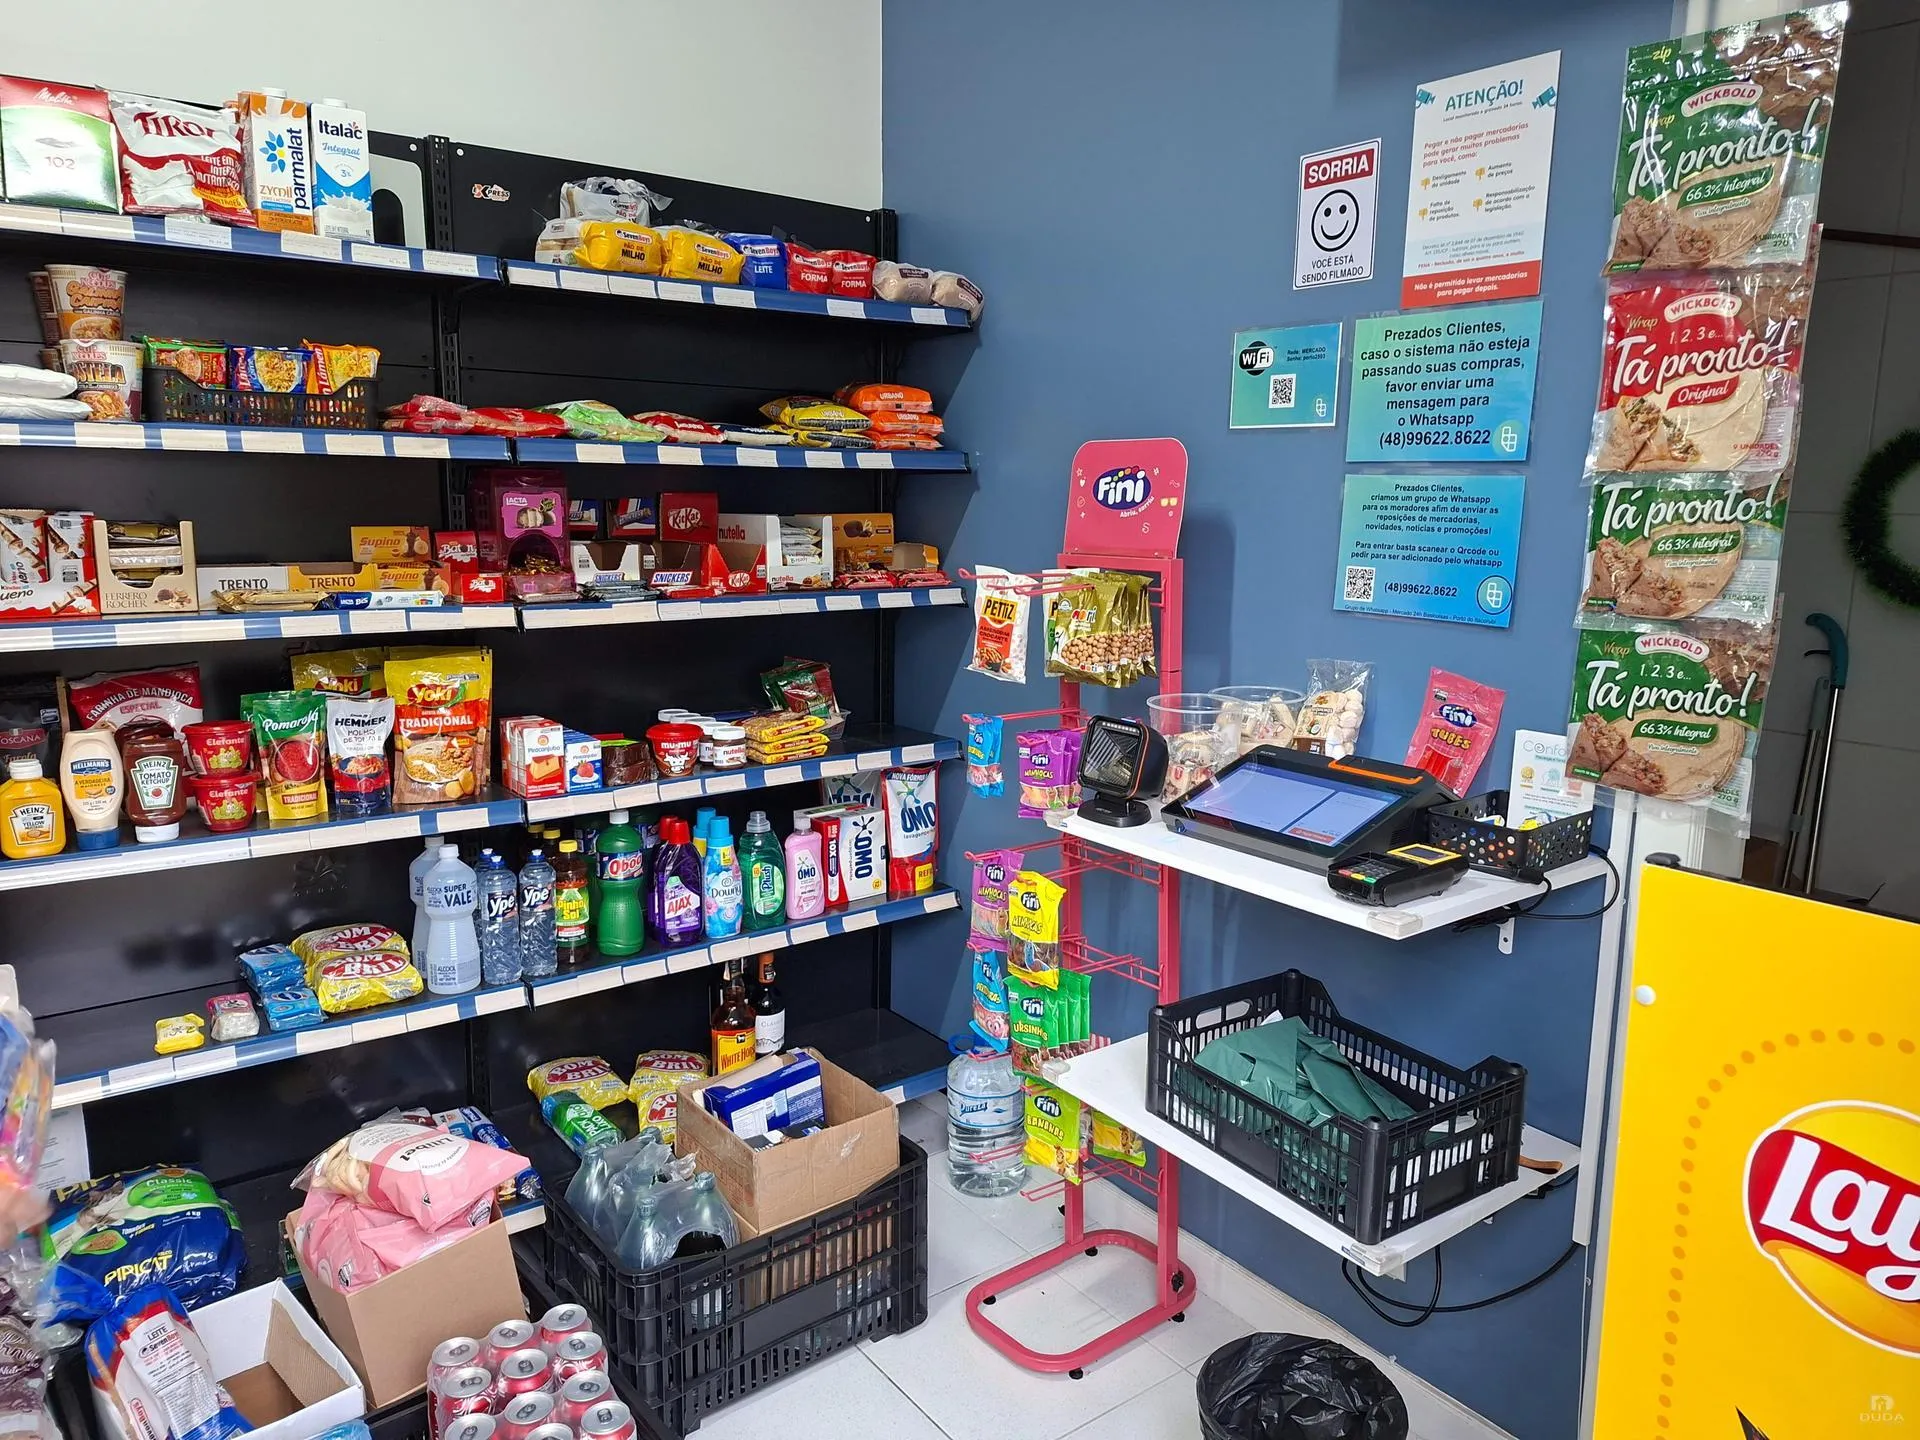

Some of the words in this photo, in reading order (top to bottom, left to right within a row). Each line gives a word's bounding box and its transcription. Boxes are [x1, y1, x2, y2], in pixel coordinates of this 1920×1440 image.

[1653, 46, 1672, 60] zip
[1446, 79, 1524, 112] ATENÇÃO!
[1687, 87, 1757, 110] WICKBOLD
[318, 119, 363, 140] Italac
[1425, 140, 1444, 150] Pegar
[1450, 136, 1462, 144] não
[1464, 133, 1484, 143] pagar
[1486, 122, 1529, 136] mercadorias
[321, 142, 361, 157] Integral
[1424, 151, 1439, 159] pode
[1441, 146, 1458, 156] gerar
[1460, 142, 1482, 150] muitos
[1484, 134, 1520, 147] problemas
[45, 156, 76, 170] 102
[286, 128, 311, 210] parmalat
[1308, 154, 1370, 183] SORRIA
[1422, 159, 1438, 168] para
[1627, 134, 1674, 196] Tá
[1723, 170, 1767, 194] Integral
[621, 249, 645, 261] MILHO
[1312, 255, 1333, 269] VOCÊ
[697, 262, 723, 275] MILHO
[754, 265, 773, 274] LEITE
[1302, 269, 1326, 284] SENDO
[1328, 265, 1363, 281] FILMADO
[801, 273, 828, 282] FORMA
[841, 280, 867, 288] FORMA
[1414, 282, 1427, 290] Não
[1434, 278, 1466, 288] permitido
[1485, 271, 1528, 282] mercadorias
[1437, 288, 1452, 297] para
[1453, 287, 1473, 296] pagar
[1384, 326, 1442, 342] Prezados
[1446, 321, 1506, 337] Clientes,
[1360, 349, 1390, 362] caso
[1393, 349, 1401, 359] o
[1404, 342, 1455, 358] sistema
[1459, 341, 1483, 354] não
[1488, 337, 1530, 353] esteja
[1362, 363, 1422, 380] passando
[1425, 361, 1457, 373] suas
[1461, 356, 1525, 374] compras,
[1612, 335, 1657, 394] Tá
[1385, 379, 1417, 394] favor
[1420, 377, 1462, 391] enviar
[1465, 377, 1494, 388] uma
[1678, 380, 1729, 405] Original
[1386, 396, 1456, 411] mensagem
[1459, 395, 1490, 410] para
[1398, 415, 1405, 427] o
[1409, 413, 1474, 428] Whatsapp
[1379, 428, 1491, 450] (48)99622.8622
[1097, 470, 1145, 505] Fini
[1394, 483, 1429, 492] Prezados
[1430, 484, 1465, 493] Clientes,
[506, 497, 527, 505] LACTA
[1414, 496, 1437, 504] grupo
[1450, 495, 1490, 504] Whatsapp
[1600, 481, 1644, 536] Tá
[1642, 473, 1776, 538] pronto!
[1362, 504, 1378, 513] para
[1390, 504, 1429, 512] moradores
[1431, 504, 1448, 513] afim
[1450, 505, 1460, 513] de
[1462, 506, 1487, 514] enviar
[672, 509, 700, 529] KitKat
[1376, 514, 1416, 524] reposições
[1429, 515, 1480, 525] mercadorias,
[719, 524, 746, 541] nutella
[1365, 523, 1404, 532] novidades,
[1405, 524, 1435, 533] notícias
[1444, 526, 1492, 536] promoções!
[359, 537, 401, 547] Supino
[1355, 541, 1371, 549] Para
[1373, 542, 1394, 550] entrar
[1396, 543, 1416, 551] basta
[1418, 545, 1448, 553] scanear
[1457, 546, 1487, 556] Qrcode
[1692, 535, 1734, 550] Integral
[1351, 551, 1369, 559] pedir
[1371, 553, 1387, 561] para
[1402, 553, 1443, 563] adicionado
[1444, 556, 1462, 564] pelo
[1464, 558, 1503, 568] whatsapp
[309, 576, 356, 588] TRENTO
[380, 570, 419, 581] Supino
[595, 574, 623, 583] SNICKERS
[654, 573, 691, 583] SNICKERS
[729, 572, 749, 586] KitKat
[219, 578, 268, 591] TRENTO
[1384, 582, 1458, 597] (48)99622.8622
[105, 592, 148, 600] FERRERO
[105, 600, 148, 609] ROCHER
[1640, 636, 1703, 656] WICKBOLD
[1665, 667, 1674, 677] 3
[415, 686, 453, 702] Yoki
[1585, 660, 1629, 711] Tá
[1626, 672, 1757, 720] pronto!
[86, 692, 125, 721] FARINHA
[126, 688, 139, 698] DE
[142, 687, 194, 705] MANDIOCA
[119, 702, 162, 714] ESPECIAL
[262, 707, 319, 732] Pomarola
[335, 716, 386, 727] HEMMER
[400, 715, 473, 727] TRADICIONAL
[1441, 706, 1473, 727] Fini
[1430, 728, 1472, 750] TUBES
[1673, 726, 1713, 740] Integral
[206, 737, 245, 746] Elefante
[139, 771, 171, 779] TOMATO
[209, 788, 248, 798] Elefante
[20, 807, 45, 816] HEINZ
[901, 802, 936, 833] OMO
[829, 840, 837, 857] 10X
[854, 836, 873, 879] OMO
[797, 867, 816, 880] OMO
[444, 884, 466, 893] SUPER
[711, 886, 742, 899] Downy
[444, 891, 472, 907] VALE
[557, 900, 584, 910] Pinho
[666, 894, 692, 914] AJAX
[562, 910, 580, 919] Sol
[344, 959, 403, 975] BRIL
[1022, 999, 1044, 1015] Fini
[551, 1059, 595, 1076] BOM
[652, 1060, 700, 1071] BRIL
[721, 1053, 740, 1070] WHITE
[567, 1063, 610, 1081] BRIL
[1037, 1097, 1060, 1116] Fini
[577, 1118, 596, 1136] PACK
[1027, 1114, 1064, 1141] BANANAS
[146, 1178, 193, 1186] Classic
[147, 1326, 168, 1341] LEITE
